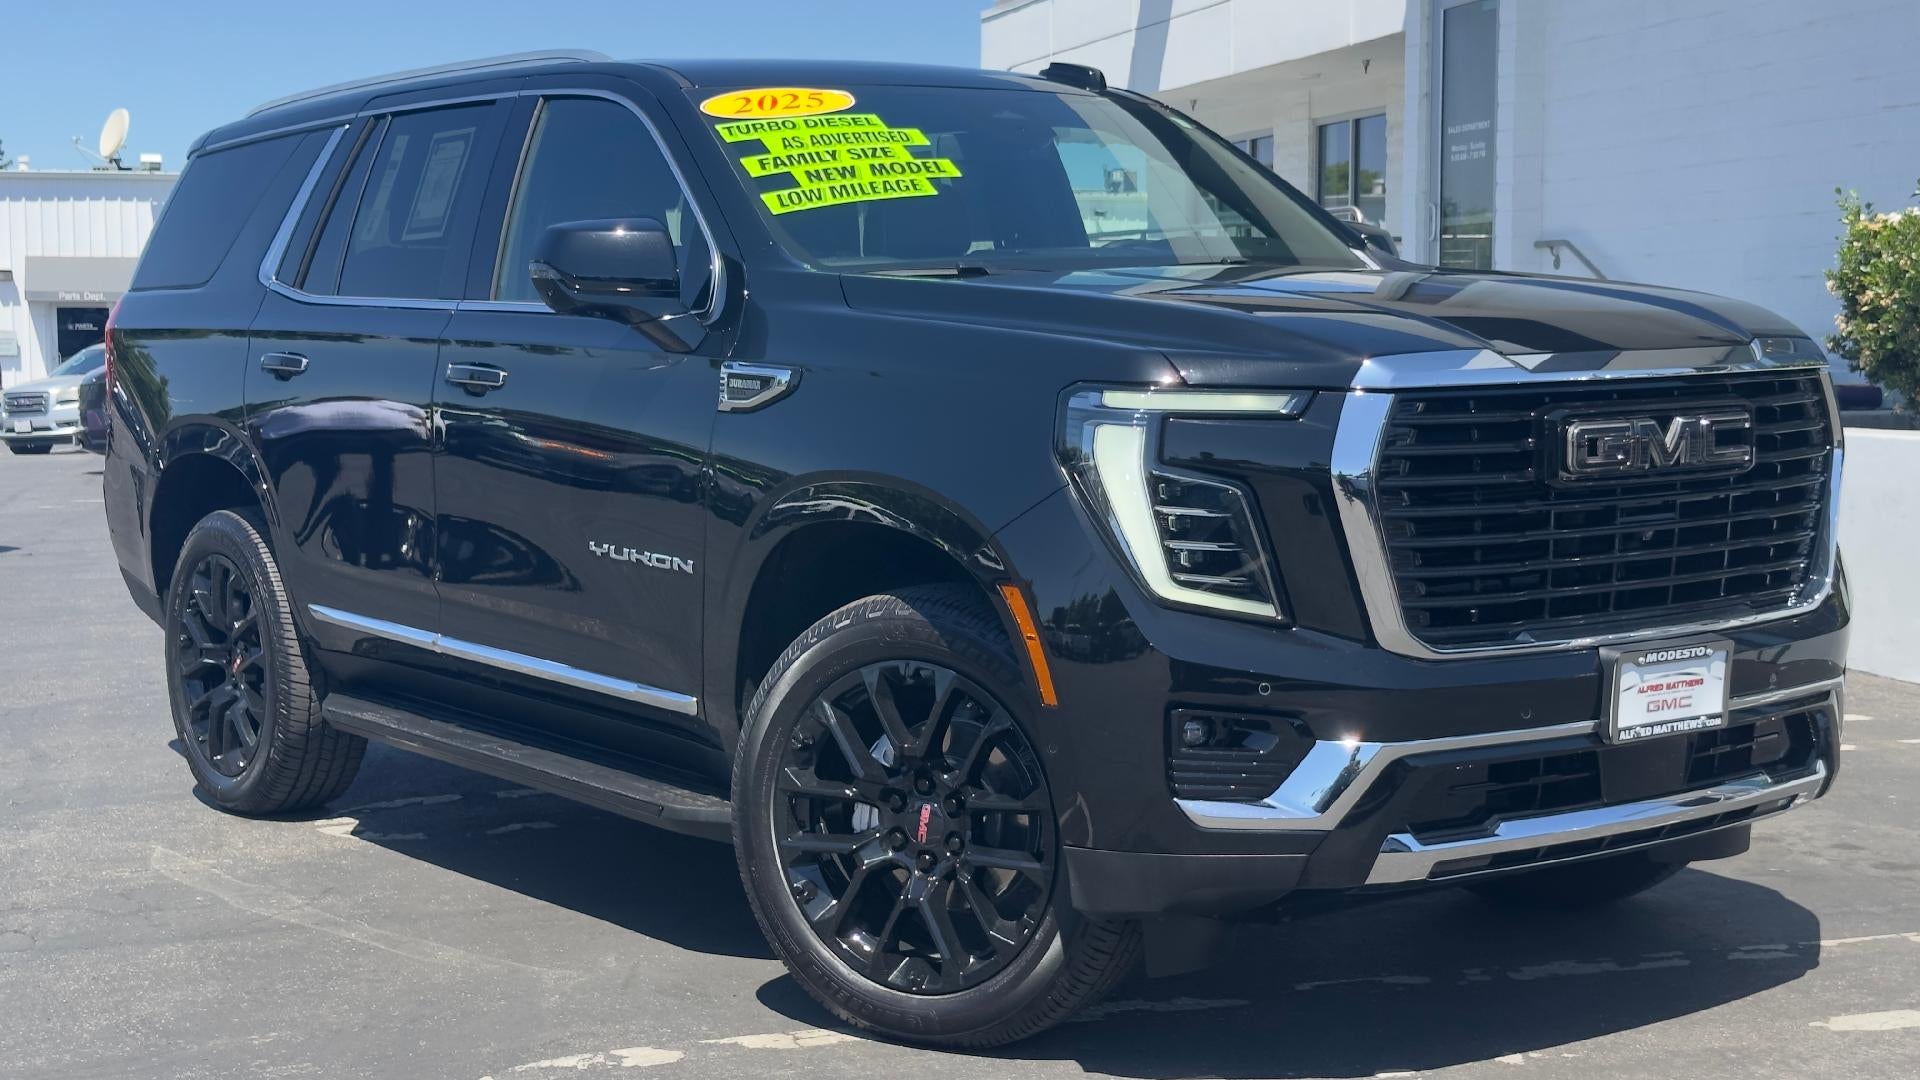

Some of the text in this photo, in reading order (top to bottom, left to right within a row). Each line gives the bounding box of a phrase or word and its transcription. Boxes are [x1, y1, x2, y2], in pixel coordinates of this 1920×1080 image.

[734, 92, 824, 114] 2025
[723, 116, 878, 138] TURBO DIESEL
[781, 129, 912, 150] AS ADVERTISED
[757, 147, 896, 171] FAMILY SIZE
[804, 160, 947, 183] NEW MODEL
[776, 178, 922, 209] LOW MILEAGE
[58, 291, 80, 301] Parts
[1566, 413, 1752, 473] GMC
[589, 541, 694, 574] YUKON
[1646, 647, 1705, 663] MODESTO
[1637, 683, 1664, 695] ALFRED
[1646, 695, 1693, 713] GMC
[917, 803, 931, 844] GMC
